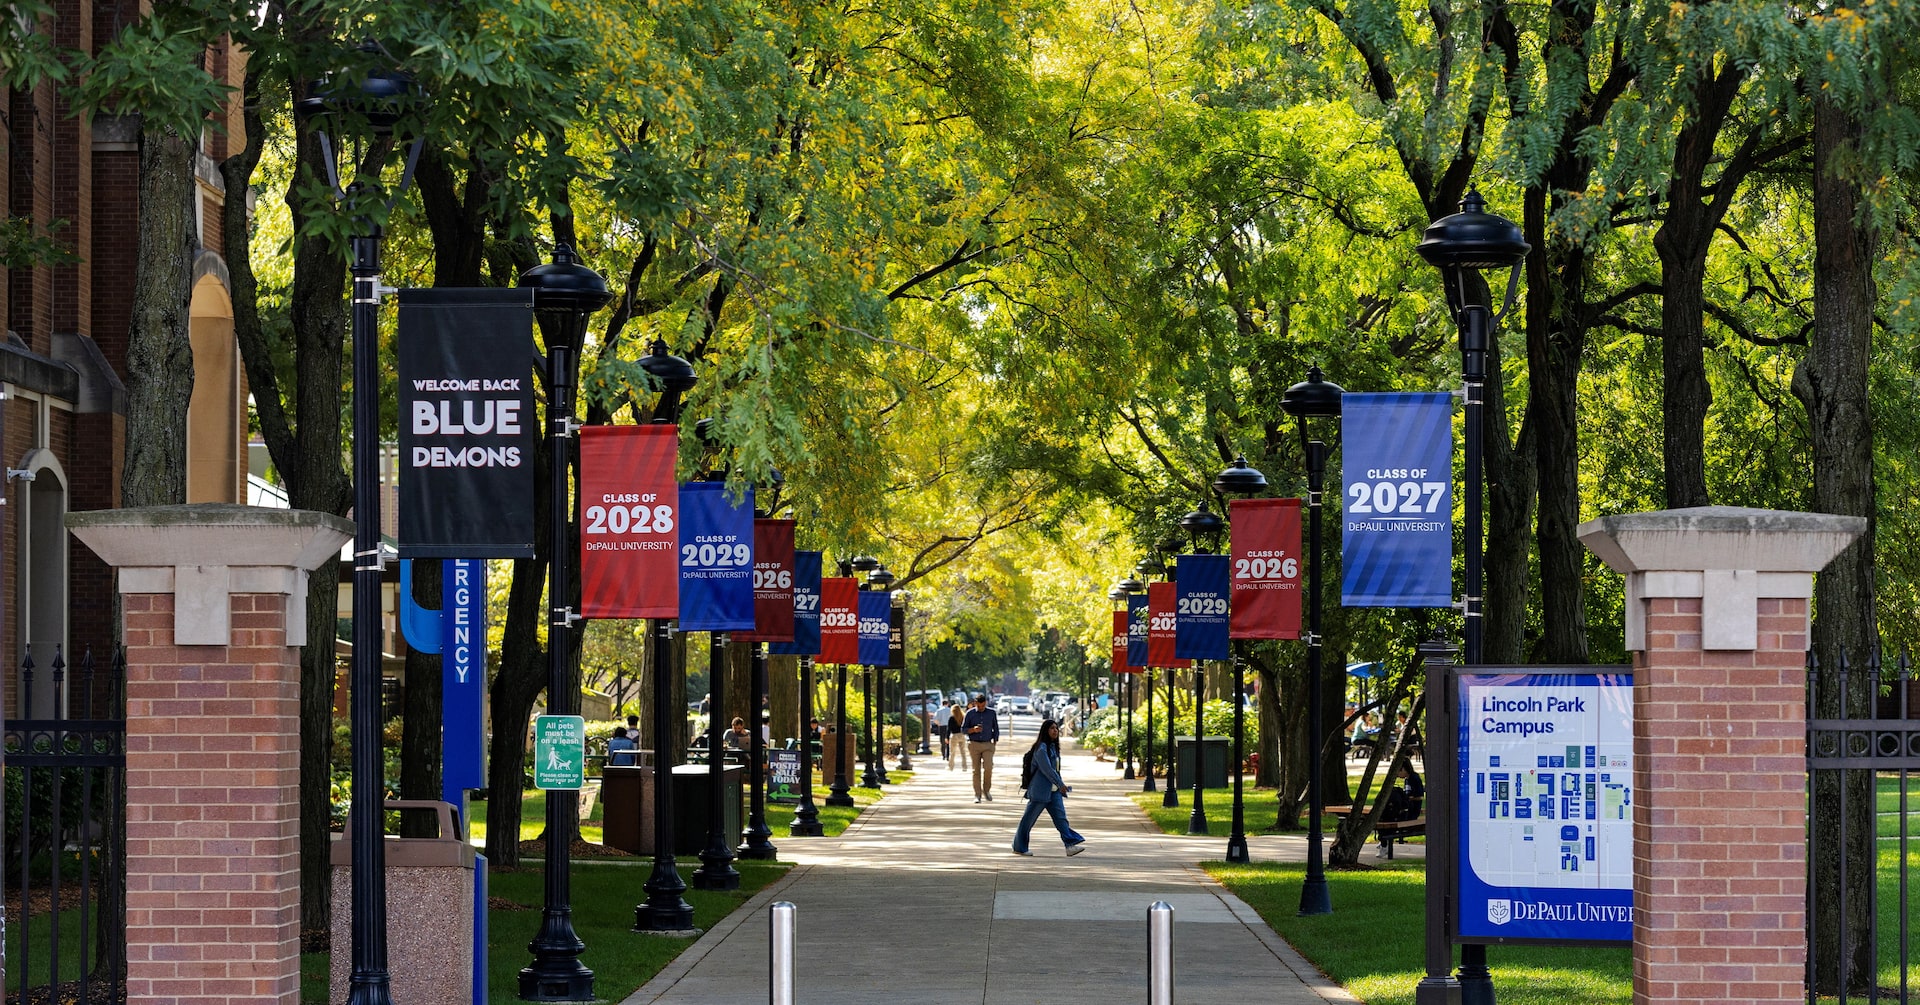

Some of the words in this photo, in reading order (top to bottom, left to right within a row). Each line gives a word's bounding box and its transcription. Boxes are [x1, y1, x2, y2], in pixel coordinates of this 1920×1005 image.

[412, 379, 480, 391] WELCOME
[483, 379, 520, 391] BACK
[412, 400, 521, 436] BLUE
[412, 446, 521, 467] DEMONS
[1367, 469, 1408, 479] CLASS
[1410, 468, 1427, 478] OF
[602, 494, 639, 503] CLASS
[642, 493, 657, 503] OF
[1348, 481, 1446, 513] 2027
[586, 505, 674, 534] 2028
[1386, 522, 1446, 532] UNIVERSITY
[620, 541, 674, 551] UNIVERSITY
[695, 535, 724, 543] CLASS
[725, 535, 737, 543] OF
[682, 543, 751, 567] 2029
[709, 571, 750, 579] UNIVERSITY
[1235, 558, 1298, 579] 2026
[753, 570, 792, 589] 026
[794, 594, 820, 610] 27
[1178, 598, 1227, 615] 2029
[820, 613, 857, 627] 2028
[1151, 617, 1177, 631] 202
[858, 621, 889, 635] 2029
[1129, 624, 1147, 636] 20
[1113, 636, 1128, 646] 20
[1482, 696, 1542, 712] Lincoln
[1547, 696, 1585, 712] Park
[558, 722, 574, 730] pets
[1482, 717, 1554, 738] Campus
[772, 776, 800, 784] TODAY
